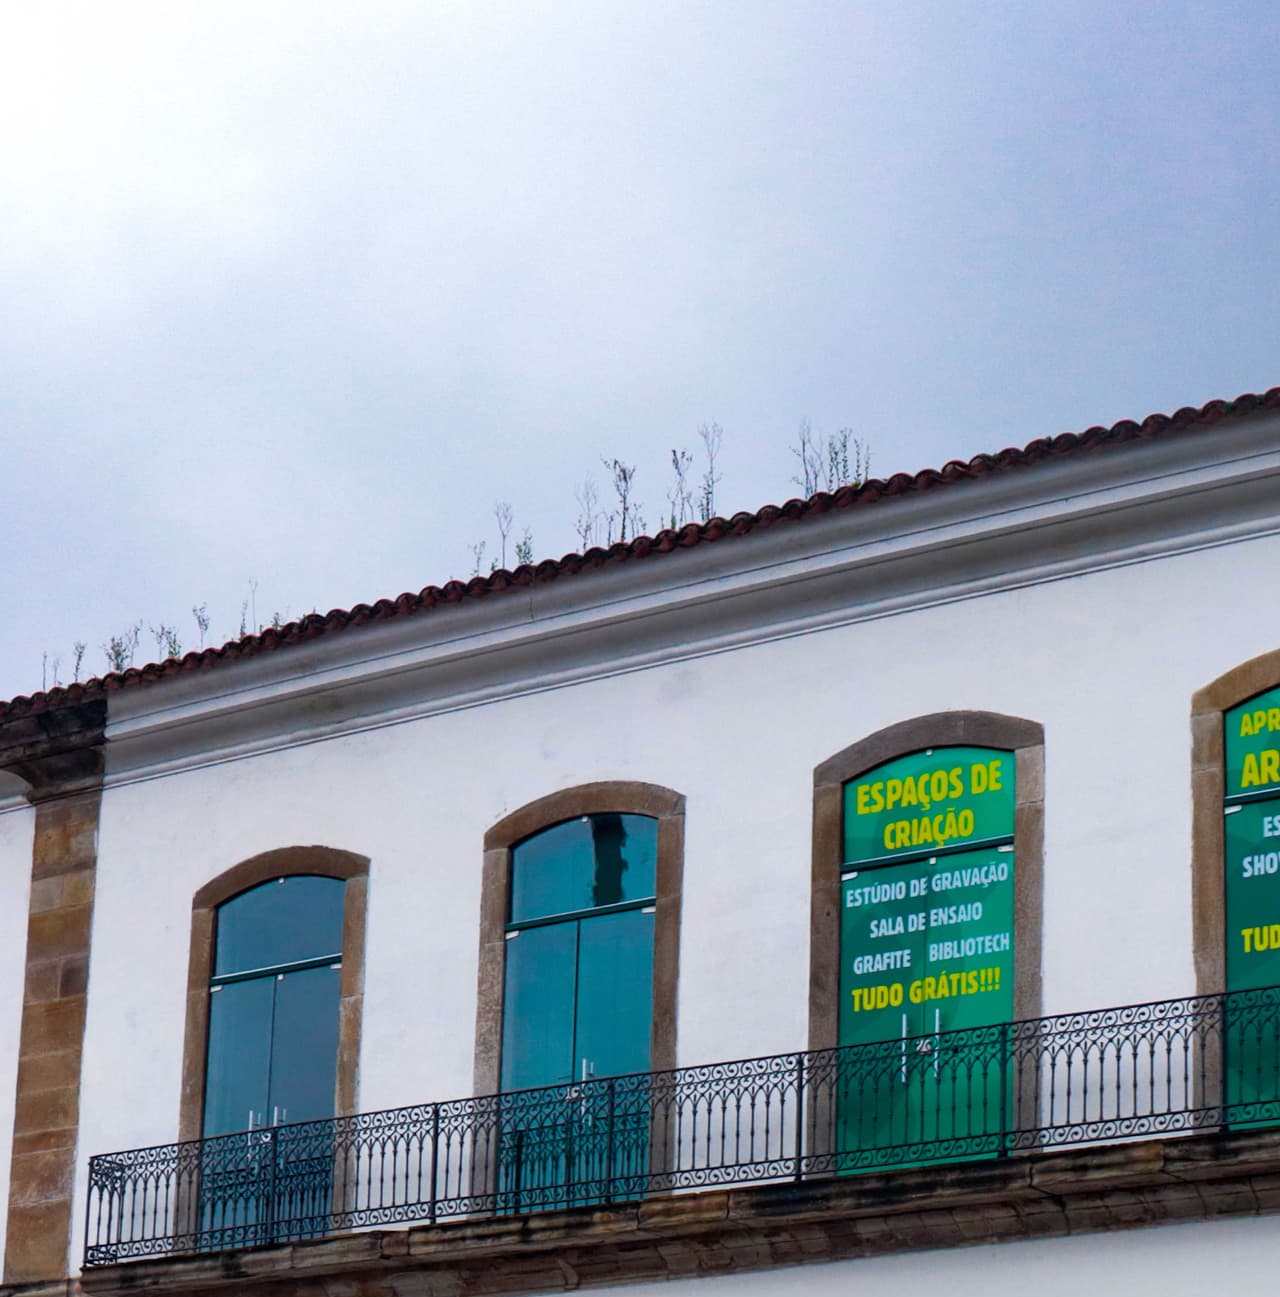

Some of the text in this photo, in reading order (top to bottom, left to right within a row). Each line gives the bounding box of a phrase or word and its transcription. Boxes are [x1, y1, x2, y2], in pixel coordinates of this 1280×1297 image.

[856, 760, 1002, 815] ESPAÇOS DE
[883, 808, 974, 848] CRIAÇÃO
[846, 861, 1008, 908] ESTÚDIO DE GRAVAÇÃO
[870, 901, 982, 938] SALA DE ENSAIO
[853, 933, 1009, 975] GRAFITE BIBLIOTECH
[851, 967, 1000, 1012] TUDO GRÁTIS!!!
